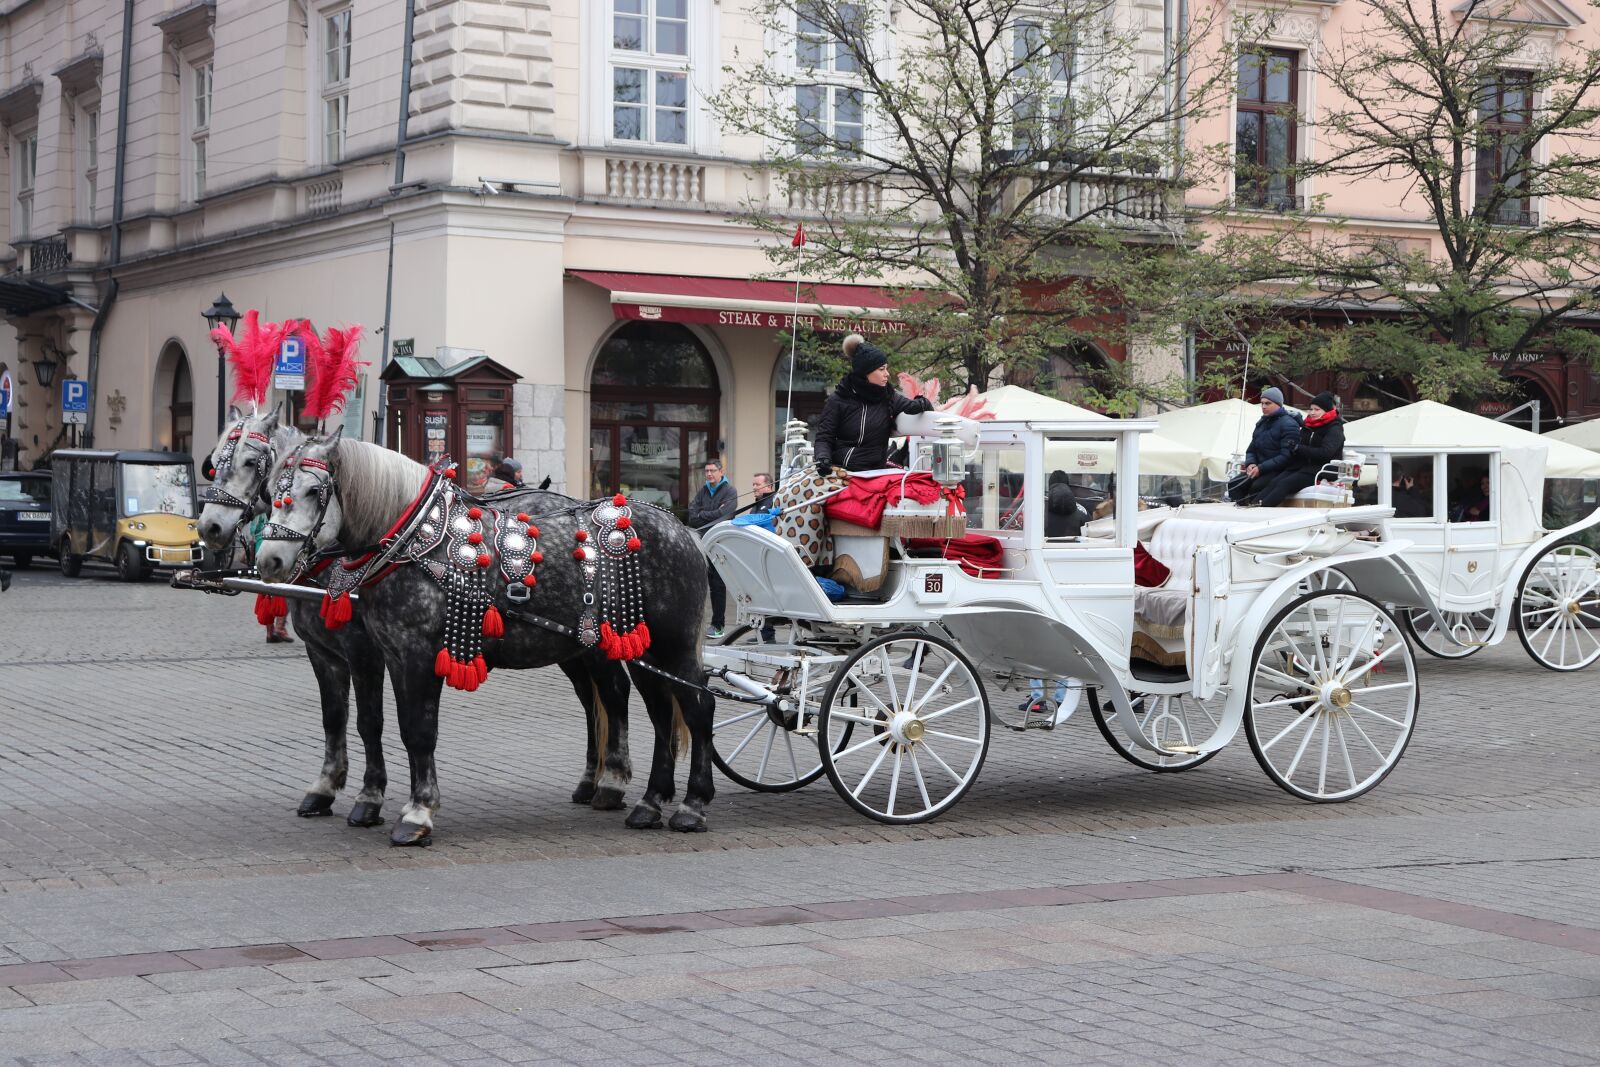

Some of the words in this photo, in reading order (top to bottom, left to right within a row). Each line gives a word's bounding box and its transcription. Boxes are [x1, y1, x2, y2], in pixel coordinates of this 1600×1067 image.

[719, 311, 761, 326] STEAK
[768, 315, 777, 327] &
[784, 315, 814, 328] FISH
[282, 340, 299, 363] P
[68, 383, 83, 402] P
[926, 581, 941, 592] 30
